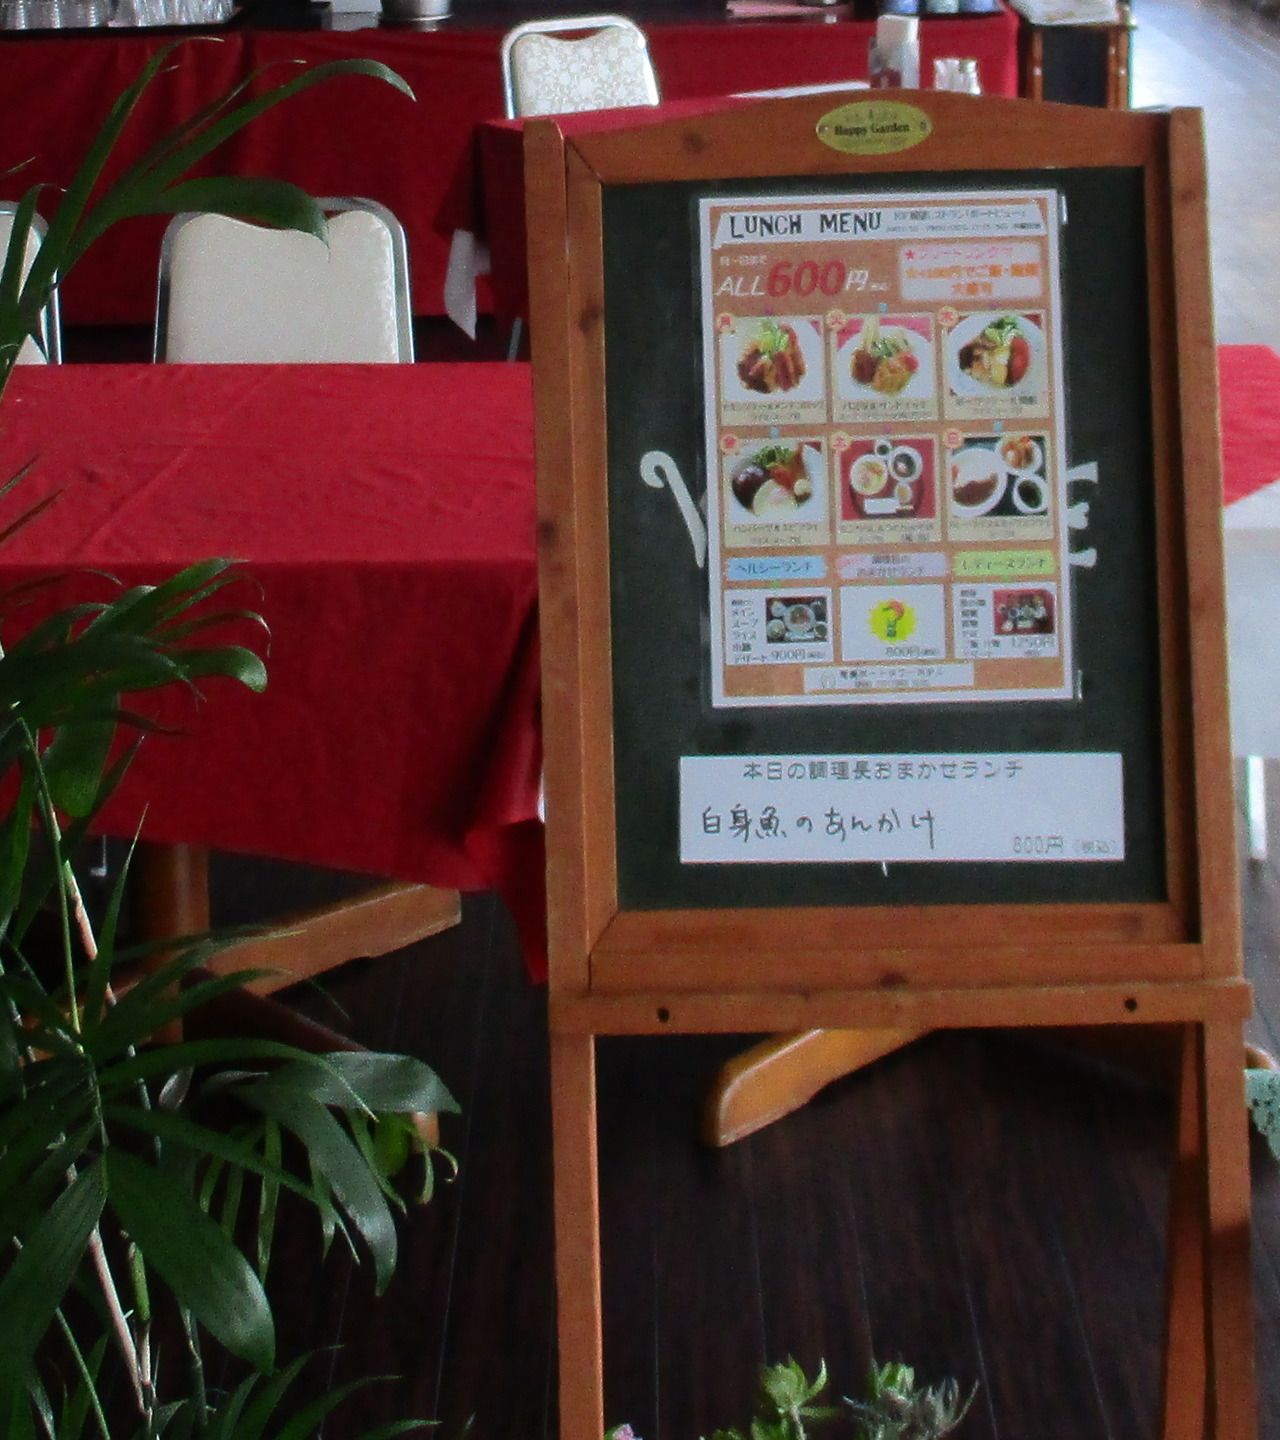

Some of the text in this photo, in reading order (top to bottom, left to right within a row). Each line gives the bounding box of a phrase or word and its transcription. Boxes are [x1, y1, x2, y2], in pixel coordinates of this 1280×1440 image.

[871, 122, 910, 134] Garden
[729, 213, 802, 239] LUNCH
[820, 211, 882, 234] MENU
[714, 261, 869, 297] ALL 600円
[736, 561, 813, 574] ヘルシーランチ
[743, 760, 1024, 782] 本日の調理長おまかせランチ
[702, 803, 936, 850] 白身魚のあんかけ
